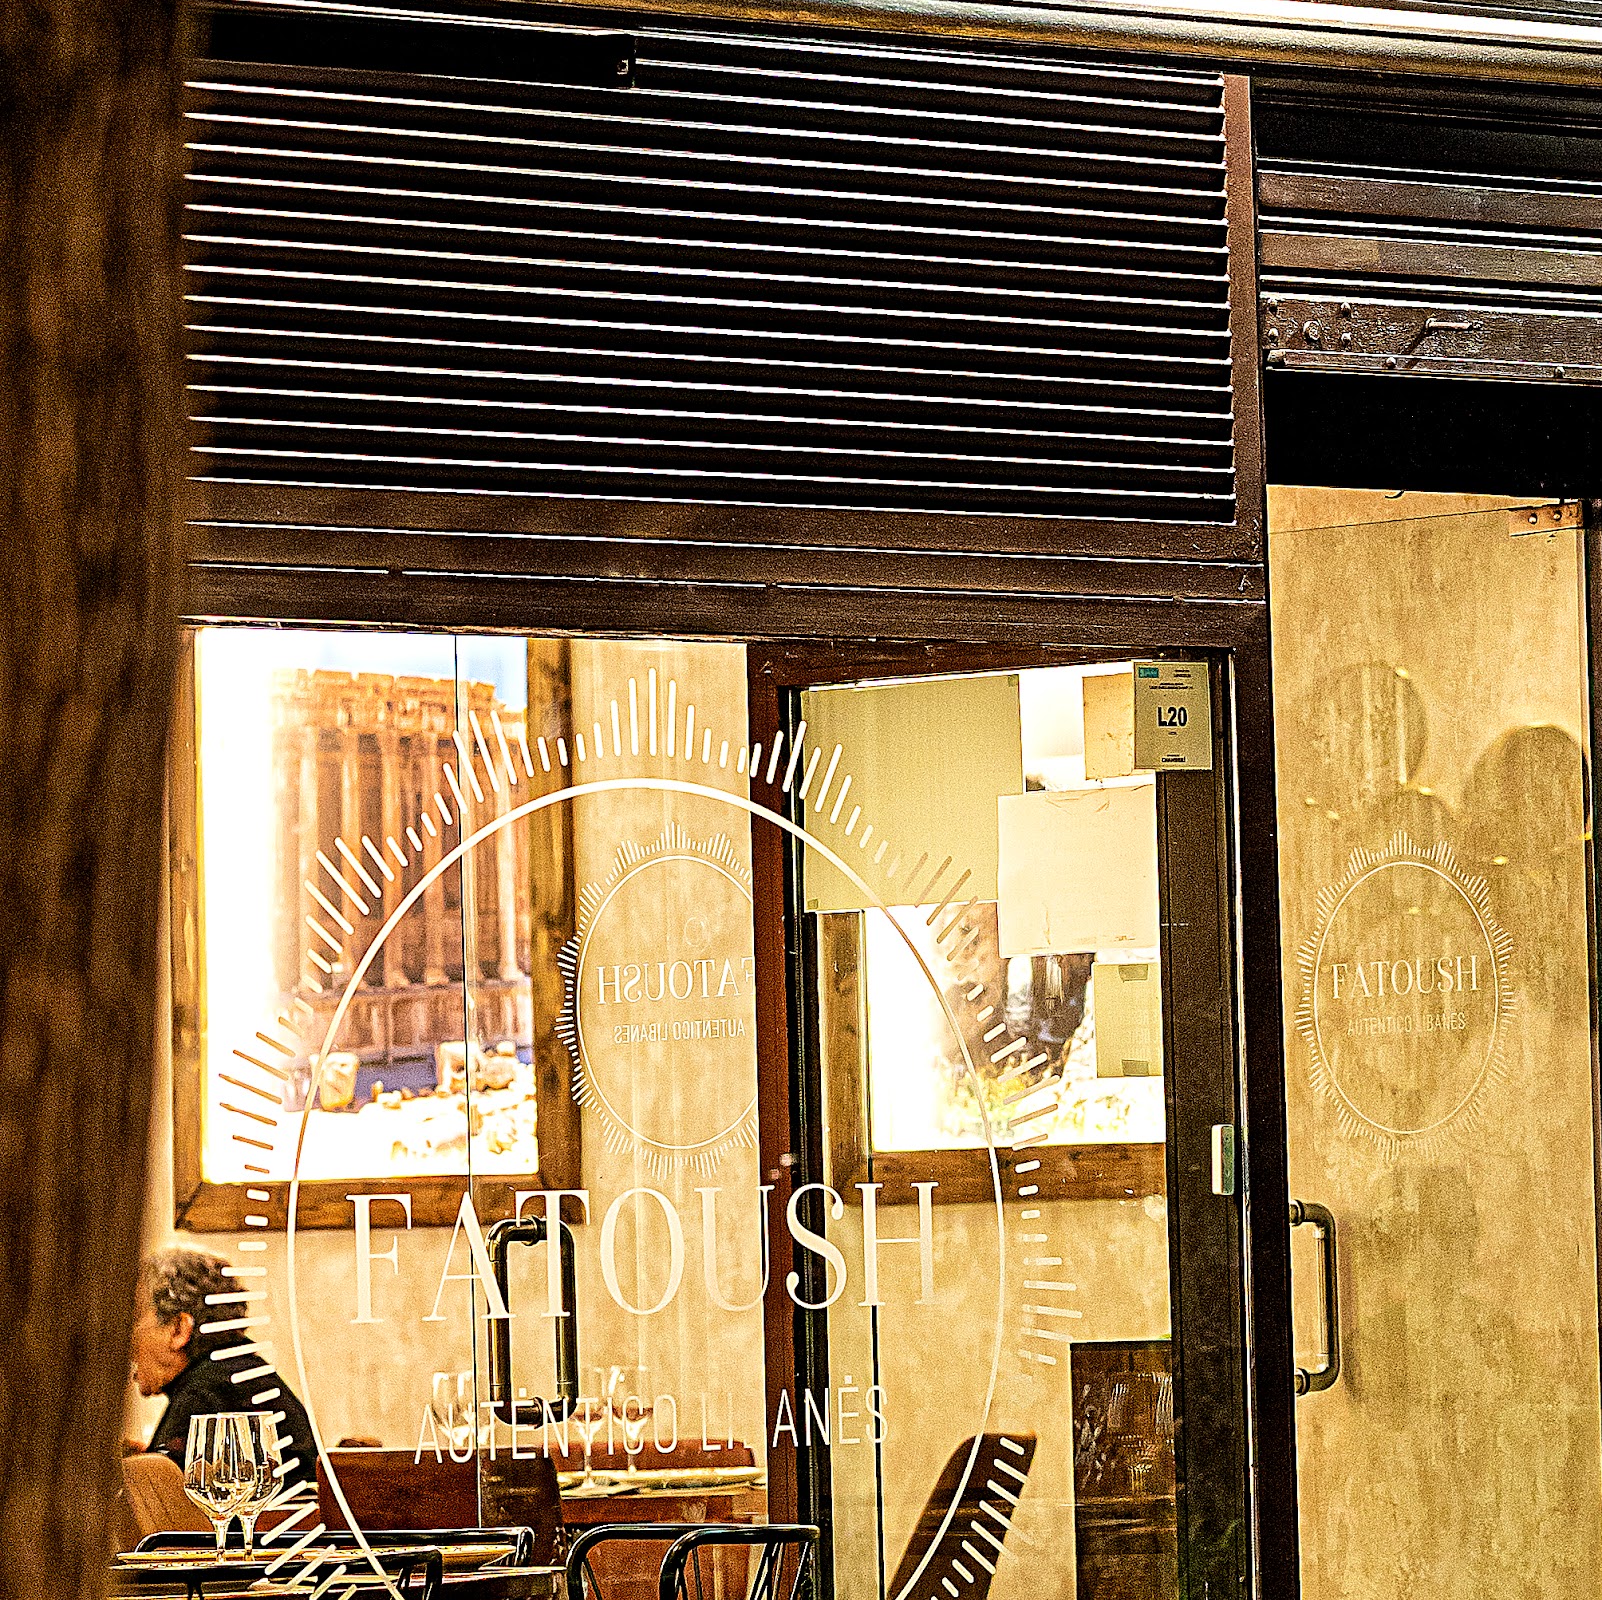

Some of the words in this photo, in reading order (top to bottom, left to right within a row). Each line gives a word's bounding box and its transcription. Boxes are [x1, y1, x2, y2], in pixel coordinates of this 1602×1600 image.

[1157, 706, 1188, 727] L20
[1331, 954, 1482, 1000] FATOUSH
[345, 1181, 940, 1324] FATOUSH
[702, 1375, 889, 1451] LIANÉS
